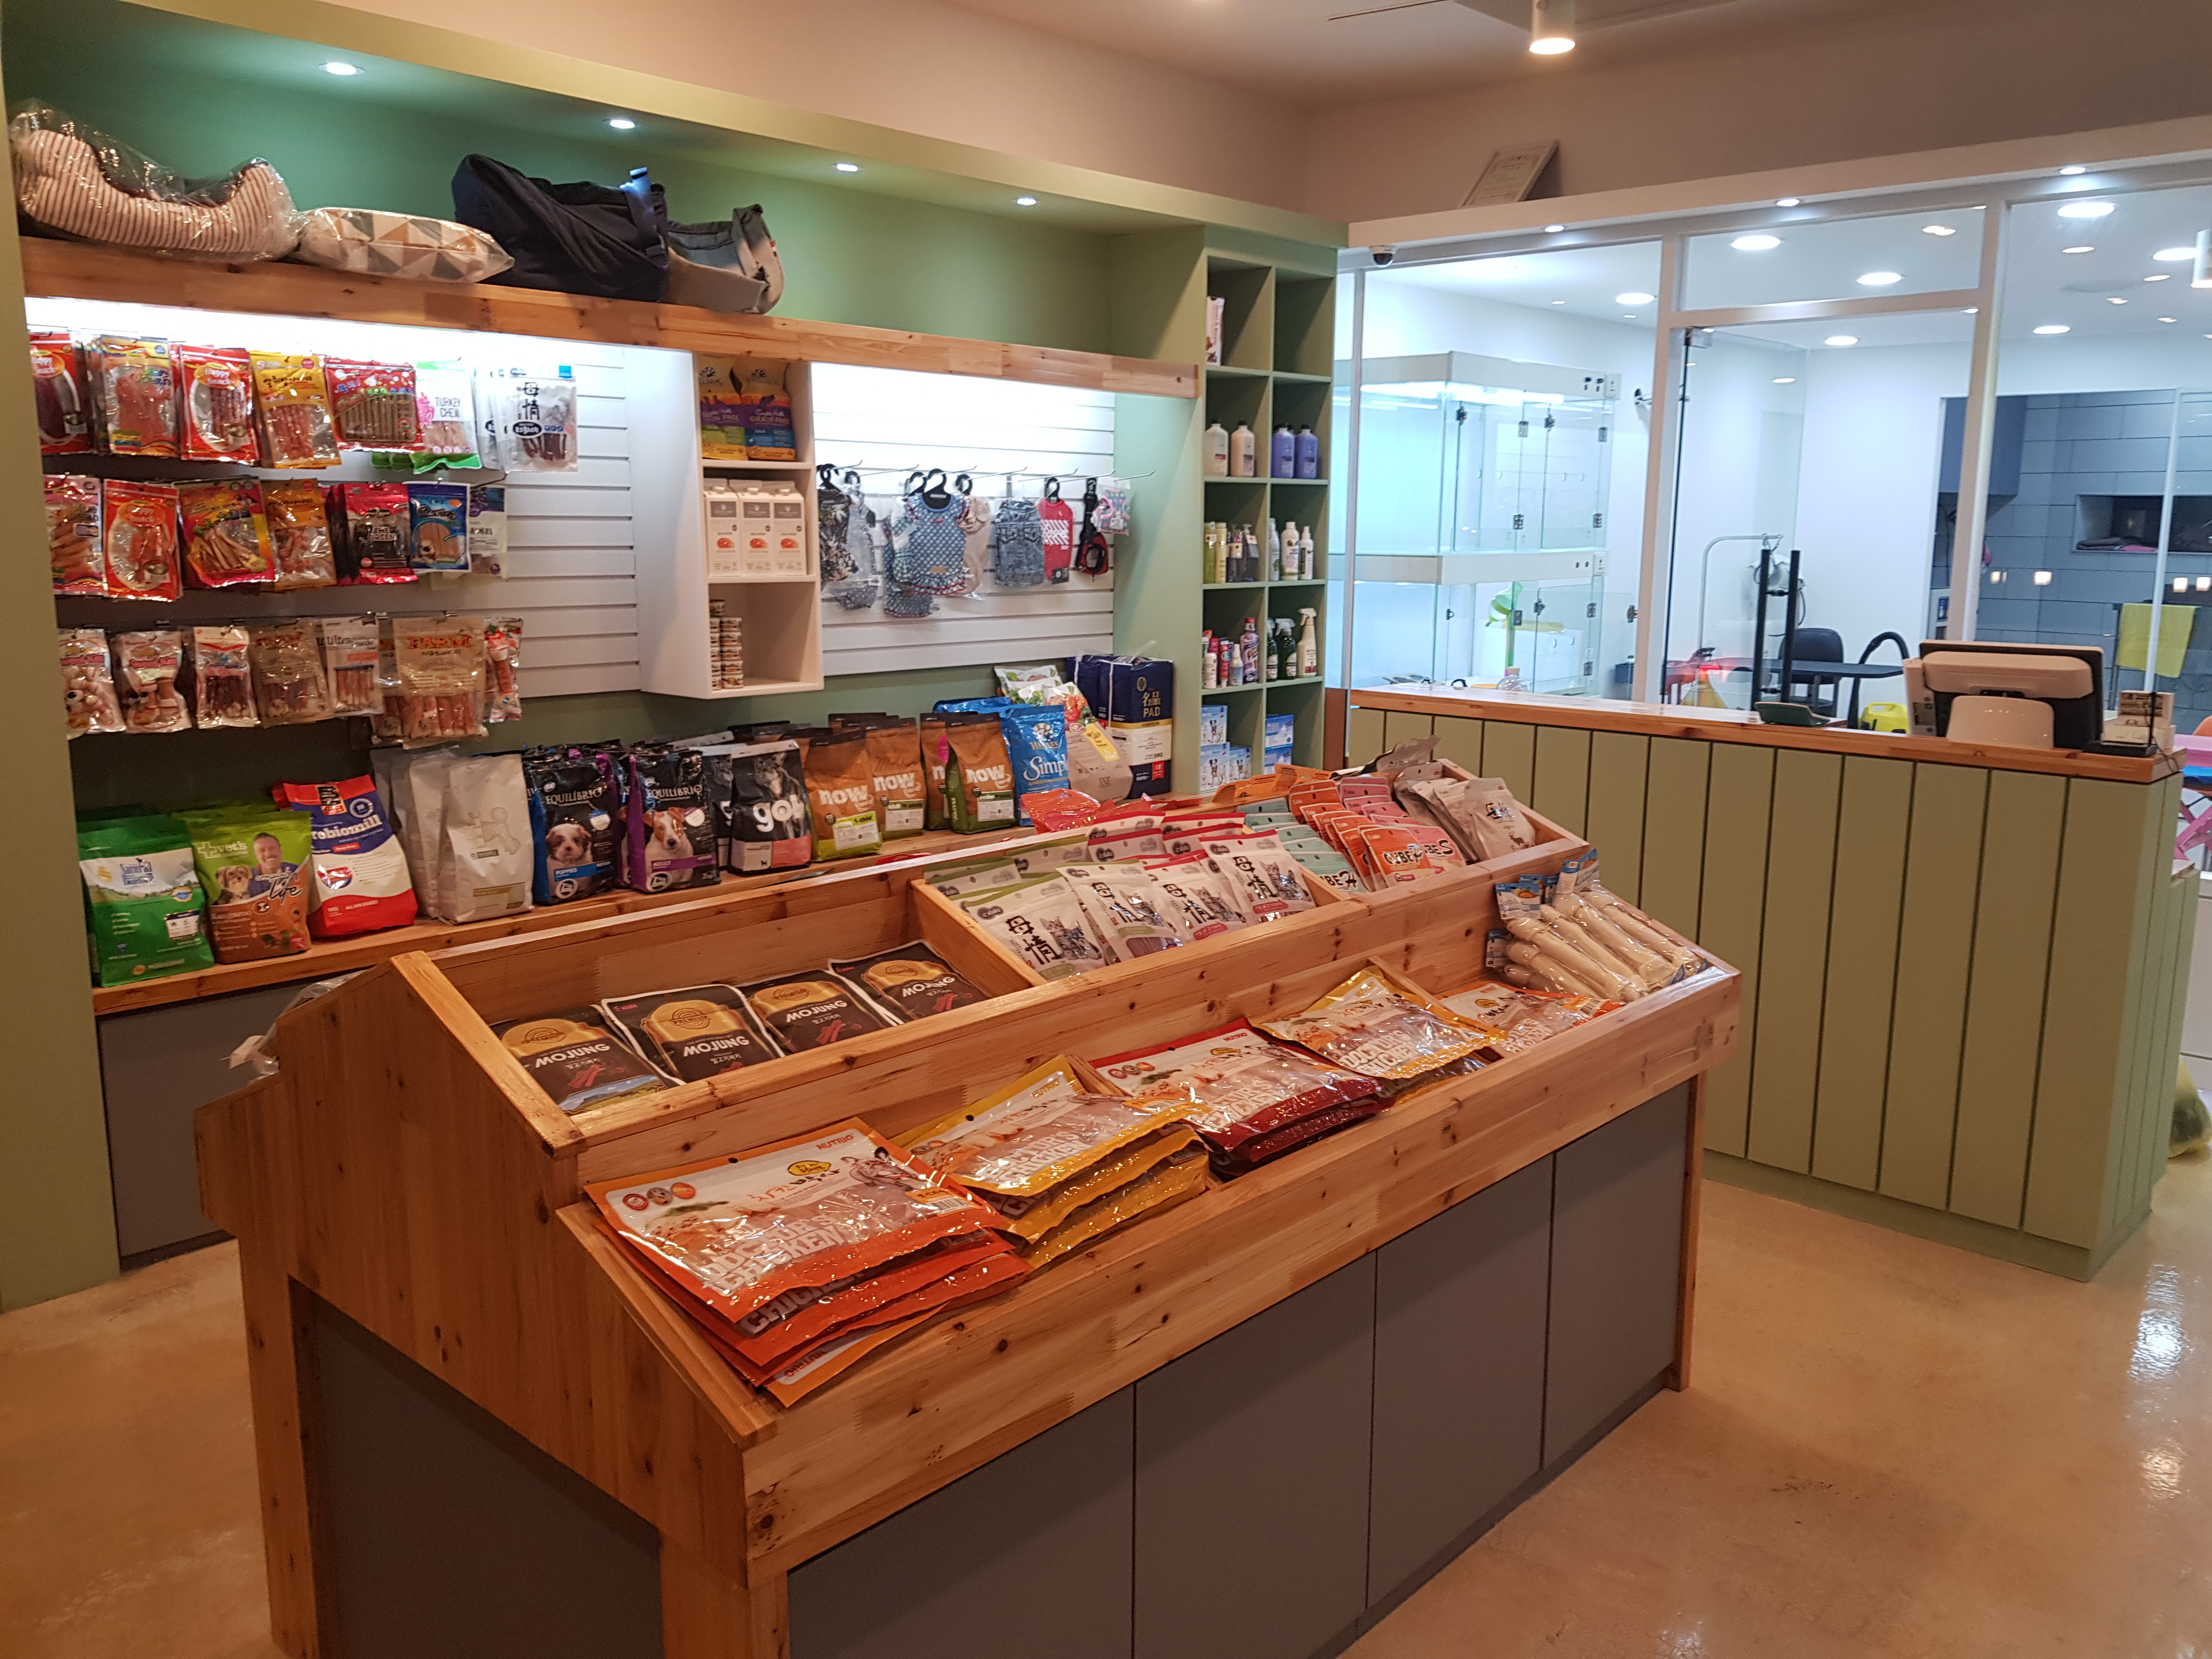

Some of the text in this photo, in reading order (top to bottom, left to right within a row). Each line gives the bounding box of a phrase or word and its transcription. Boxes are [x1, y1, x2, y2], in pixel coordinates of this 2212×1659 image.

[436, 397, 460, 407] TURKEY
[523, 382, 540, 420] 母情
[440, 408, 460, 418] CHEW
[409, 636, 471, 650] FARM
[1143, 707, 1161, 718] PAD
[965, 764, 1006, 783] now
[1023, 754, 1069, 781] Simpl
[873, 772, 916, 792] now
[818, 784, 868, 805] now
[311, 814, 383, 840] robiomill
[217, 841, 247, 853] vet's
[1233, 856, 1278, 900] 母情
[1006, 916, 1062, 965] 母情
[901, 975, 957, 998] MOJUNG
[672, 1014, 710, 1026] PREMIUM
[786, 999, 849, 1023] MOJUNG
[682, 1035, 751, 1058] MOJUNG
[1223, 1032, 1248, 1042] NUTRIO
[535, 1042, 611, 1069] MOJUNG
[1340, 1030, 1412, 1069] DOCTOR'S
[816, 1134, 854, 1150] NUTRIO
[1000, 1141, 1088, 1186] CHICKEN
[697, 1214, 839, 1280] DOCTOR'S
[716, 1223, 847, 1293] CHICKEN
